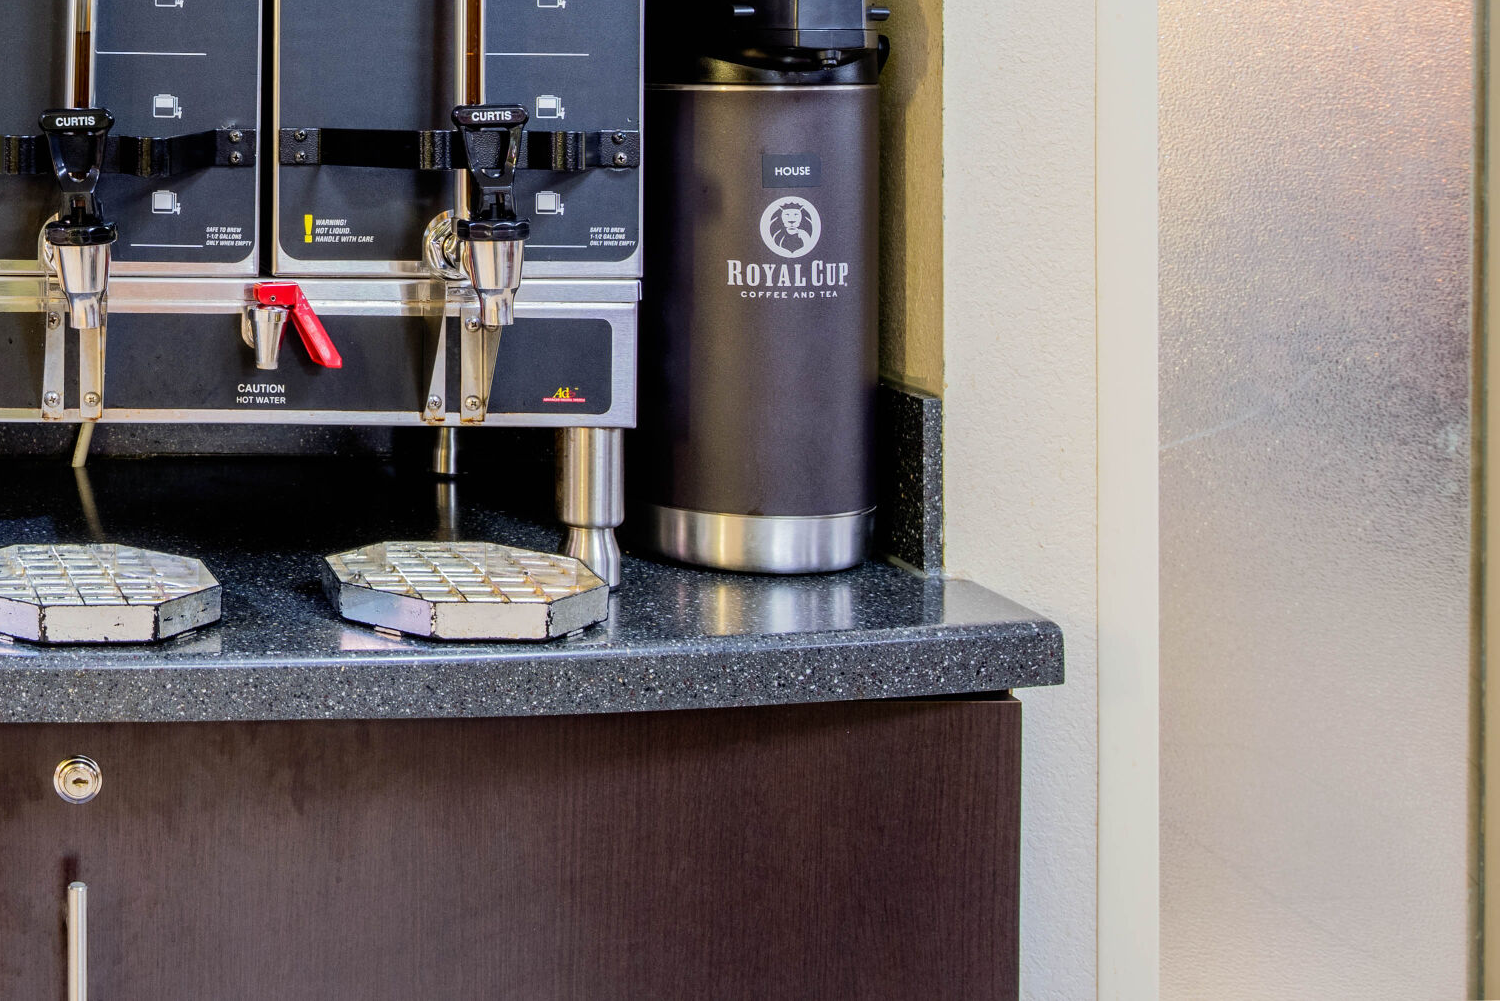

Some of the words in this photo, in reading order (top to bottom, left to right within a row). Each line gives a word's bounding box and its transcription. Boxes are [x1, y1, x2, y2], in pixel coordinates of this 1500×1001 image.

[471, 110, 512, 122] CURTIS
[55, 116, 96, 128] CURTIS
[775, 166, 811, 176] HOUSE
[727, 260, 806, 286] ROYAL
[811, 260, 848, 286] CUP
[237, 384, 285, 393] CAUTION
[236, 396, 253, 404] HOT
[255, 396, 286, 404] WATER
